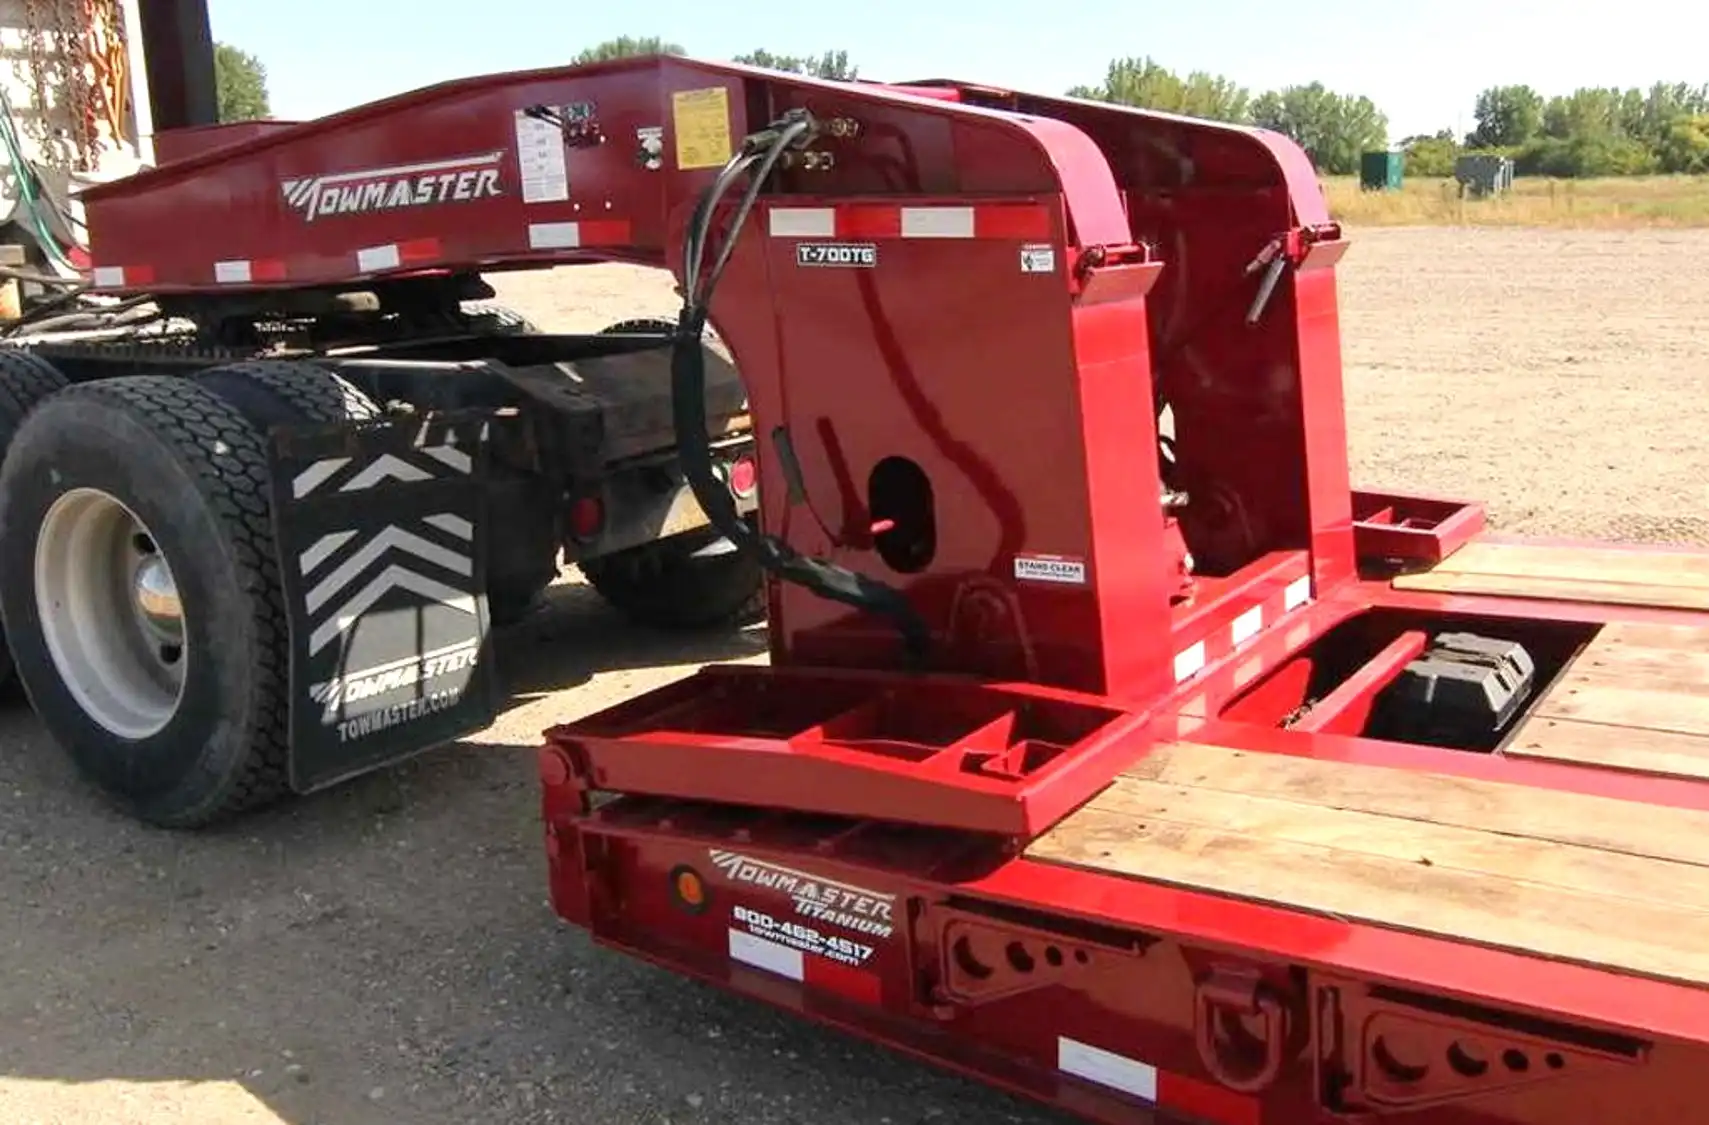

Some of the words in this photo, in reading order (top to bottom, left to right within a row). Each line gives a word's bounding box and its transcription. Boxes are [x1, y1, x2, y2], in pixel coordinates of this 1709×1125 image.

[281, 151, 503, 221] TOWMASTER
[1018, 560, 1049, 571] STAND
[1050, 563, 1081, 573] CLEAR
[337, 687, 460, 743] TOWMASTER.COM
[709, 849, 897, 921] TOWMASTER
[733, 904, 875, 960] 800-462-4517
[791, 895, 894, 938] TITANIUM
